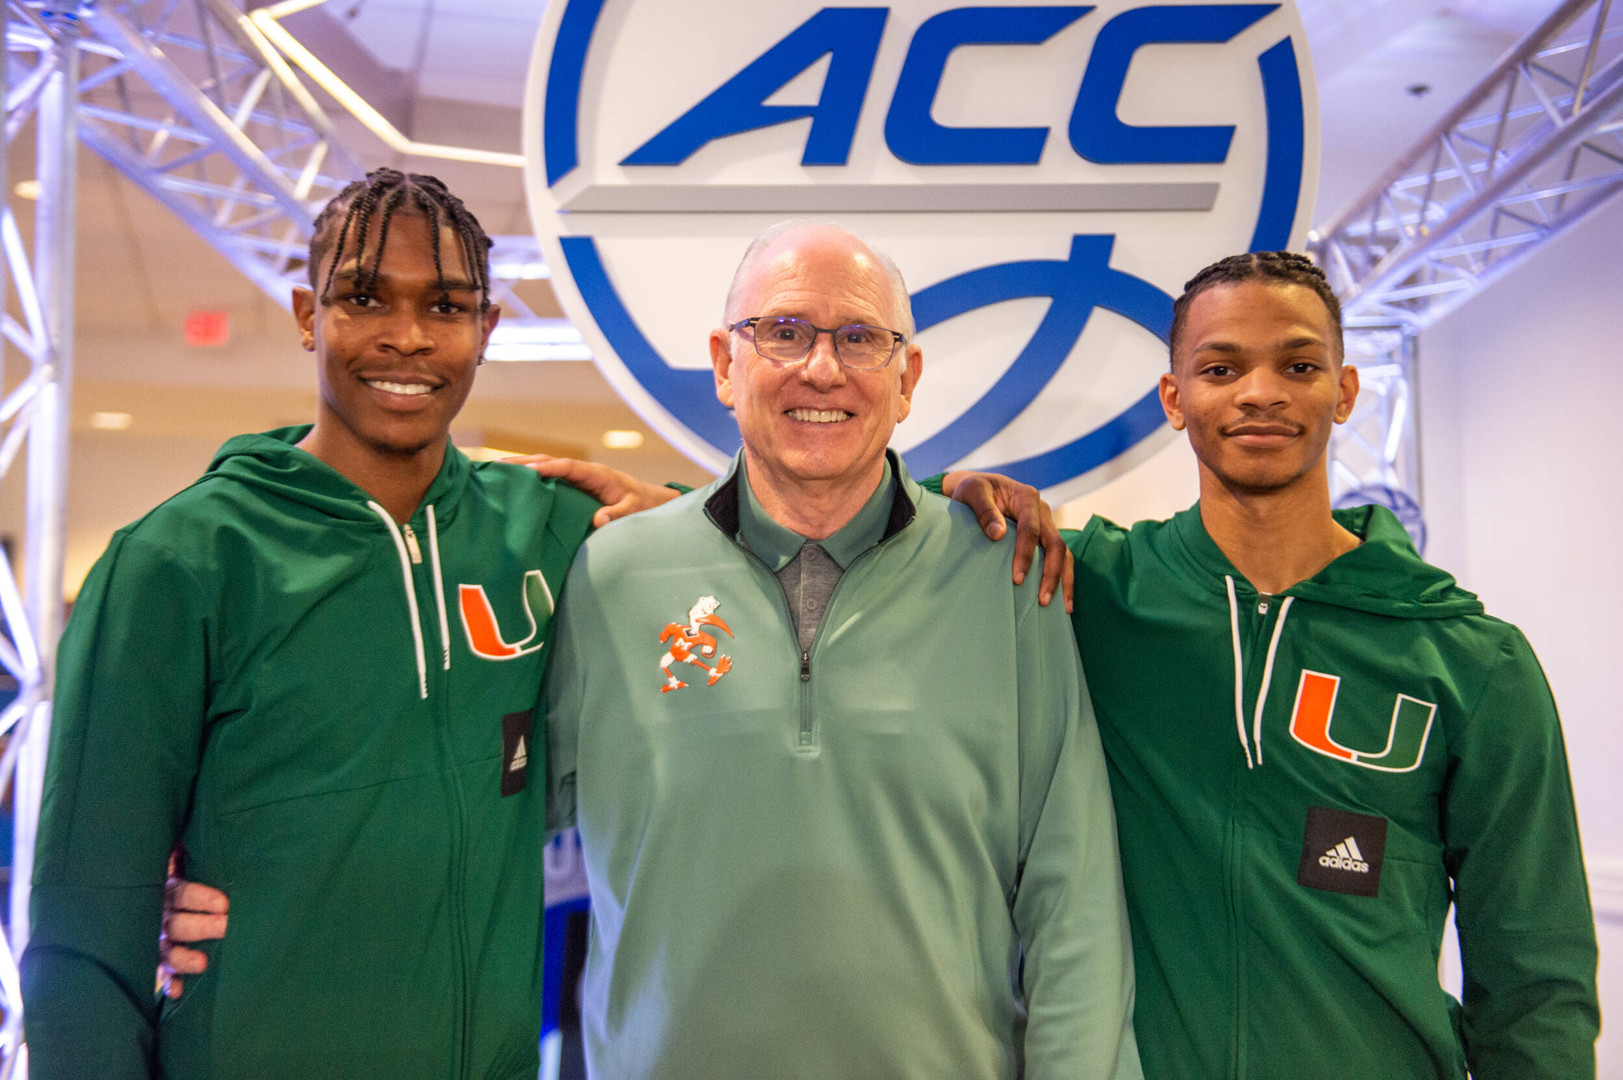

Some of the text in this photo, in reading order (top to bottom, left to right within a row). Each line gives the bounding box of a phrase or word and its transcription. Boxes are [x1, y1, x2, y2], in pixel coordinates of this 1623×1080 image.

[617, 4, 1283, 165] ACC
[457, 569, 555, 660] U
[1289, 669, 1438, 773] U
[1318, 855, 1370, 873] adidas
